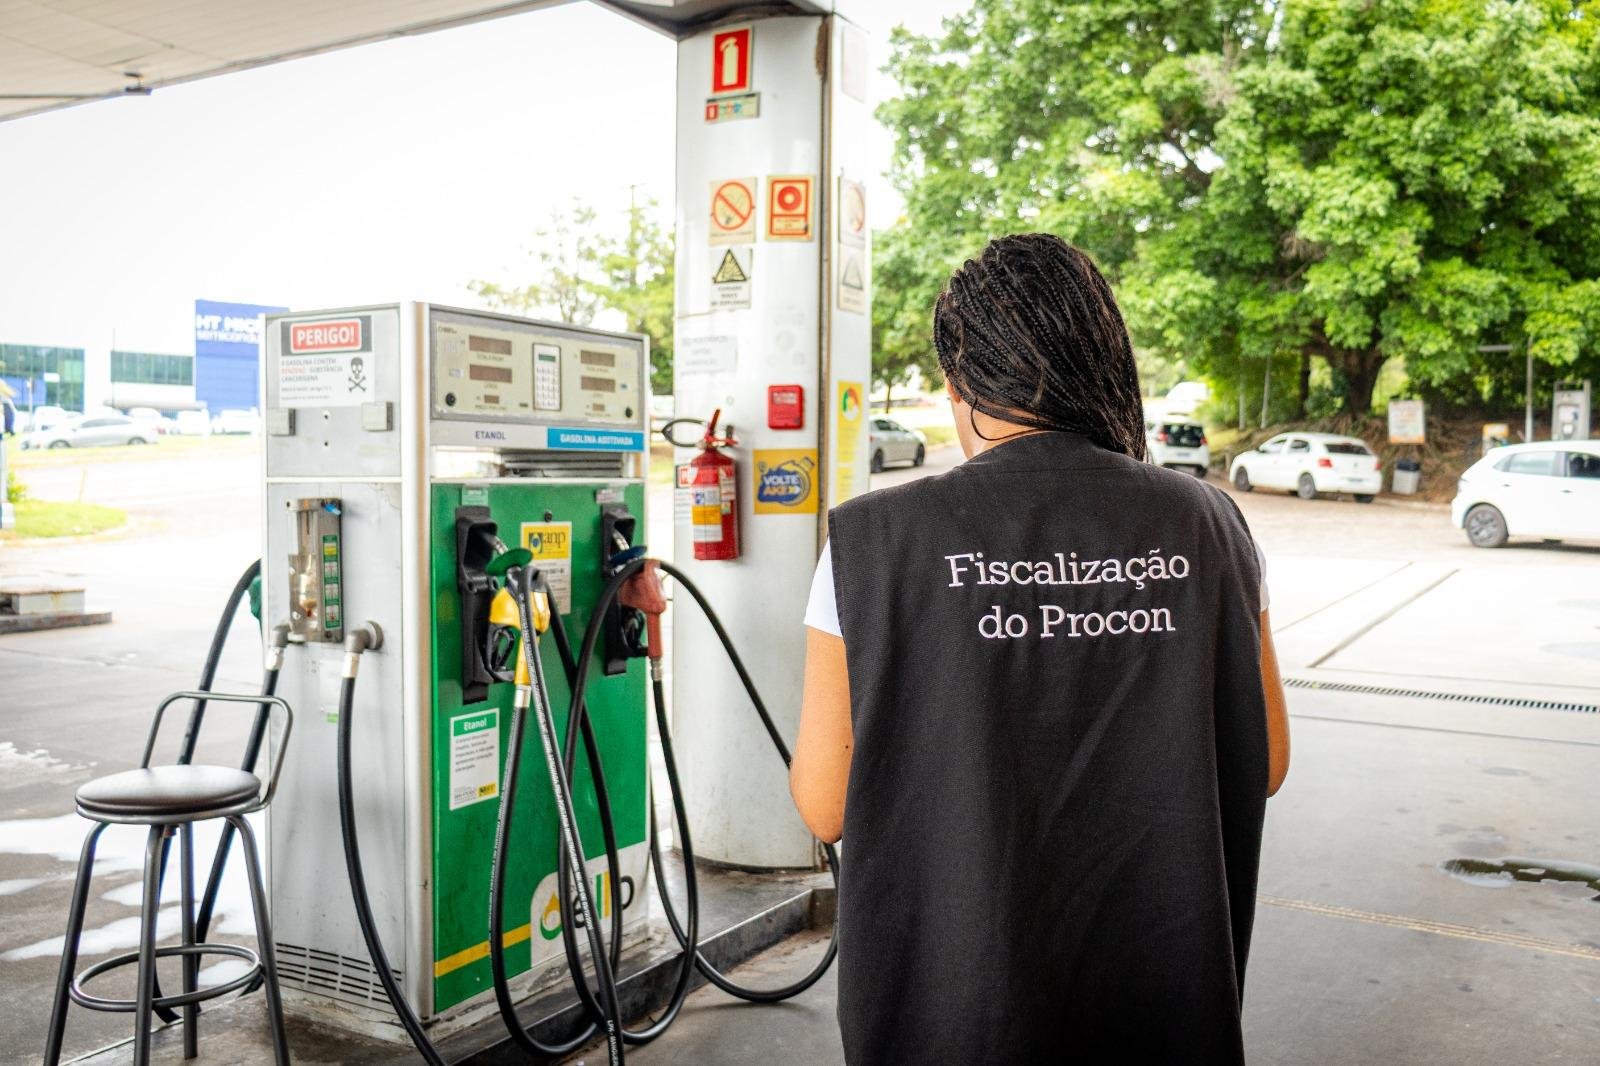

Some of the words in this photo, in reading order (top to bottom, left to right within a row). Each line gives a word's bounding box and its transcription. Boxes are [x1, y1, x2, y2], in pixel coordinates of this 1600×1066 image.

[296, 326, 355, 347] PERIGO!
[475, 430, 506, 441] ETANOL
[560, 433, 596, 443] GASOLINA
[763, 474, 799, 486] VOLTE
[544, 531, 566, 548] anp
[944, 548, 1190, 590] Fiscalização
[978, 605, 1028, 639] do
[1038, 604, 1176, 639] Procon
[463, 718, 487, 731] Etanol
